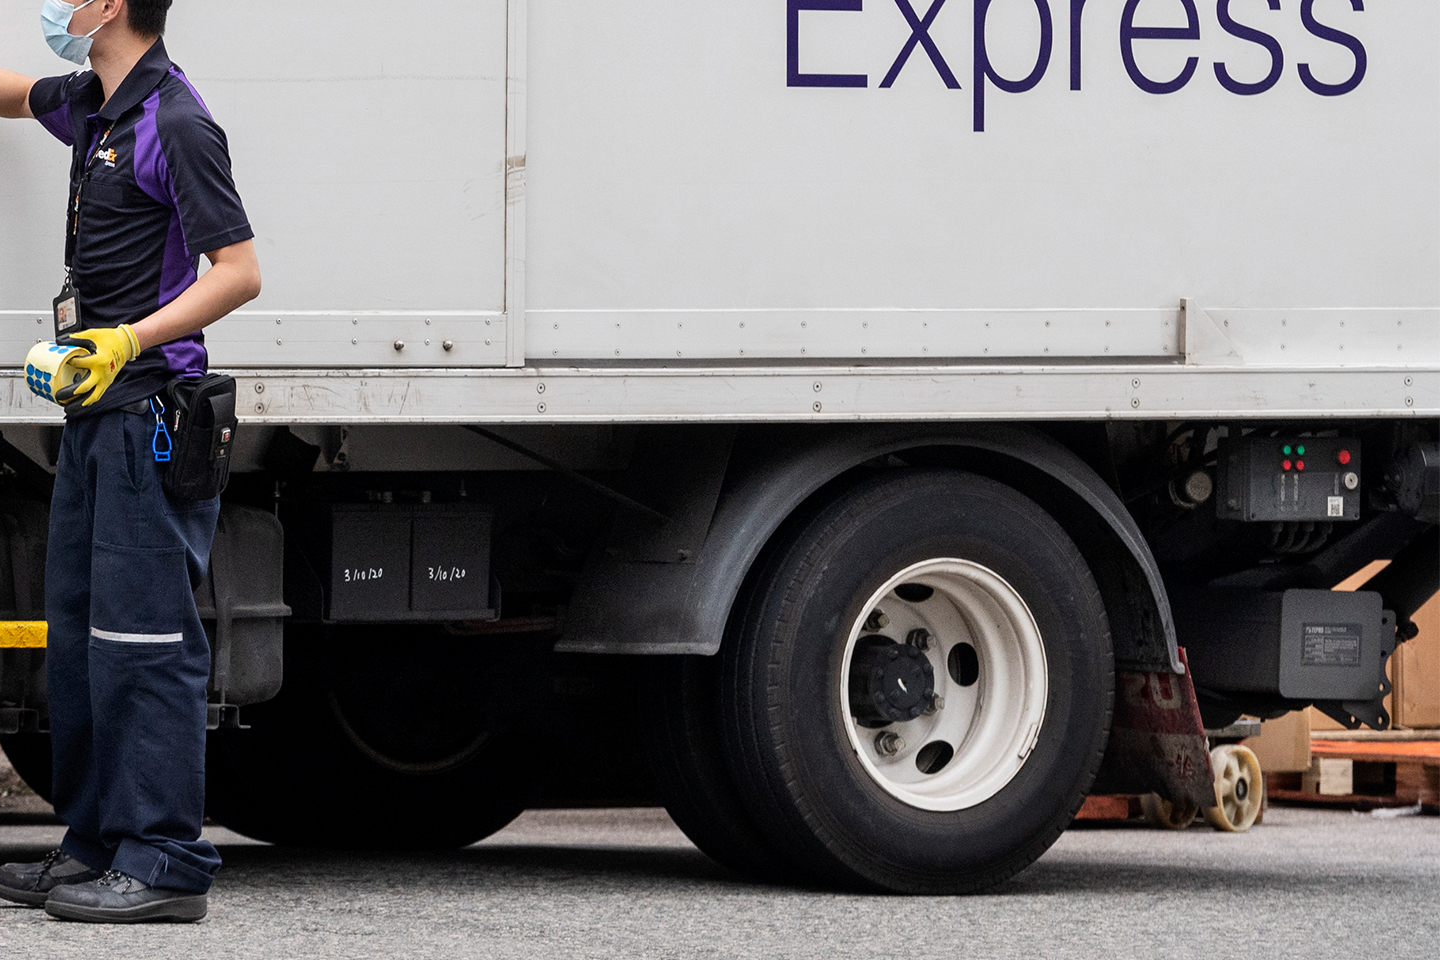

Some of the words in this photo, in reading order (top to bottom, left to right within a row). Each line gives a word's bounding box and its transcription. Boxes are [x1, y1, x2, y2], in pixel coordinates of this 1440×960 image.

[96, 148, 118, 162] edEx
[344, 568, 383, 582] 3/10/20
[428, 565, 466, 581] 3/10/20
